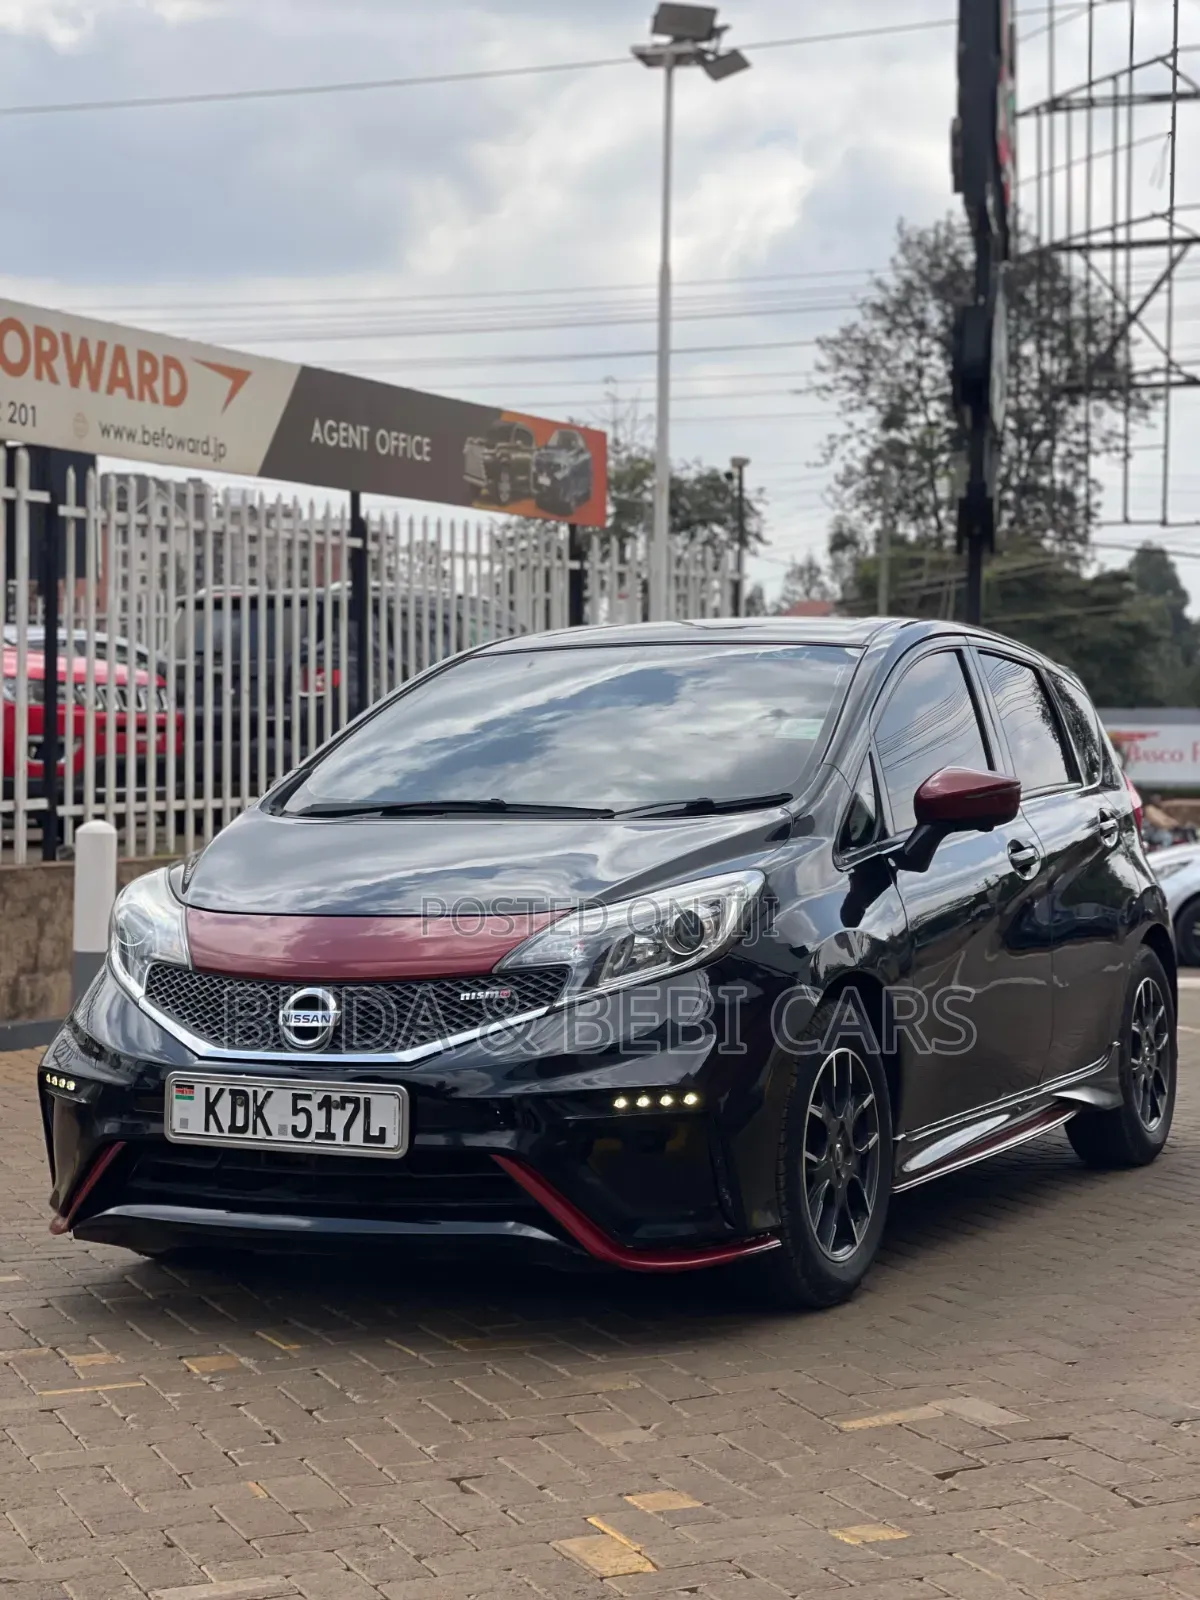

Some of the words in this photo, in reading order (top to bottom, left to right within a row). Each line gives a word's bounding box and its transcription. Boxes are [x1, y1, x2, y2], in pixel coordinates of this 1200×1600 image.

[8, 401, 37, 427] 201
[310, 417, 370, 452] AGENT
[375, 428, 431, 462] OFFICE
[282, 1013, 332, 1025] NISSAN
[204, 1087, 274, 1137] KDK
[291, 1092, 387, 1145] 517L
